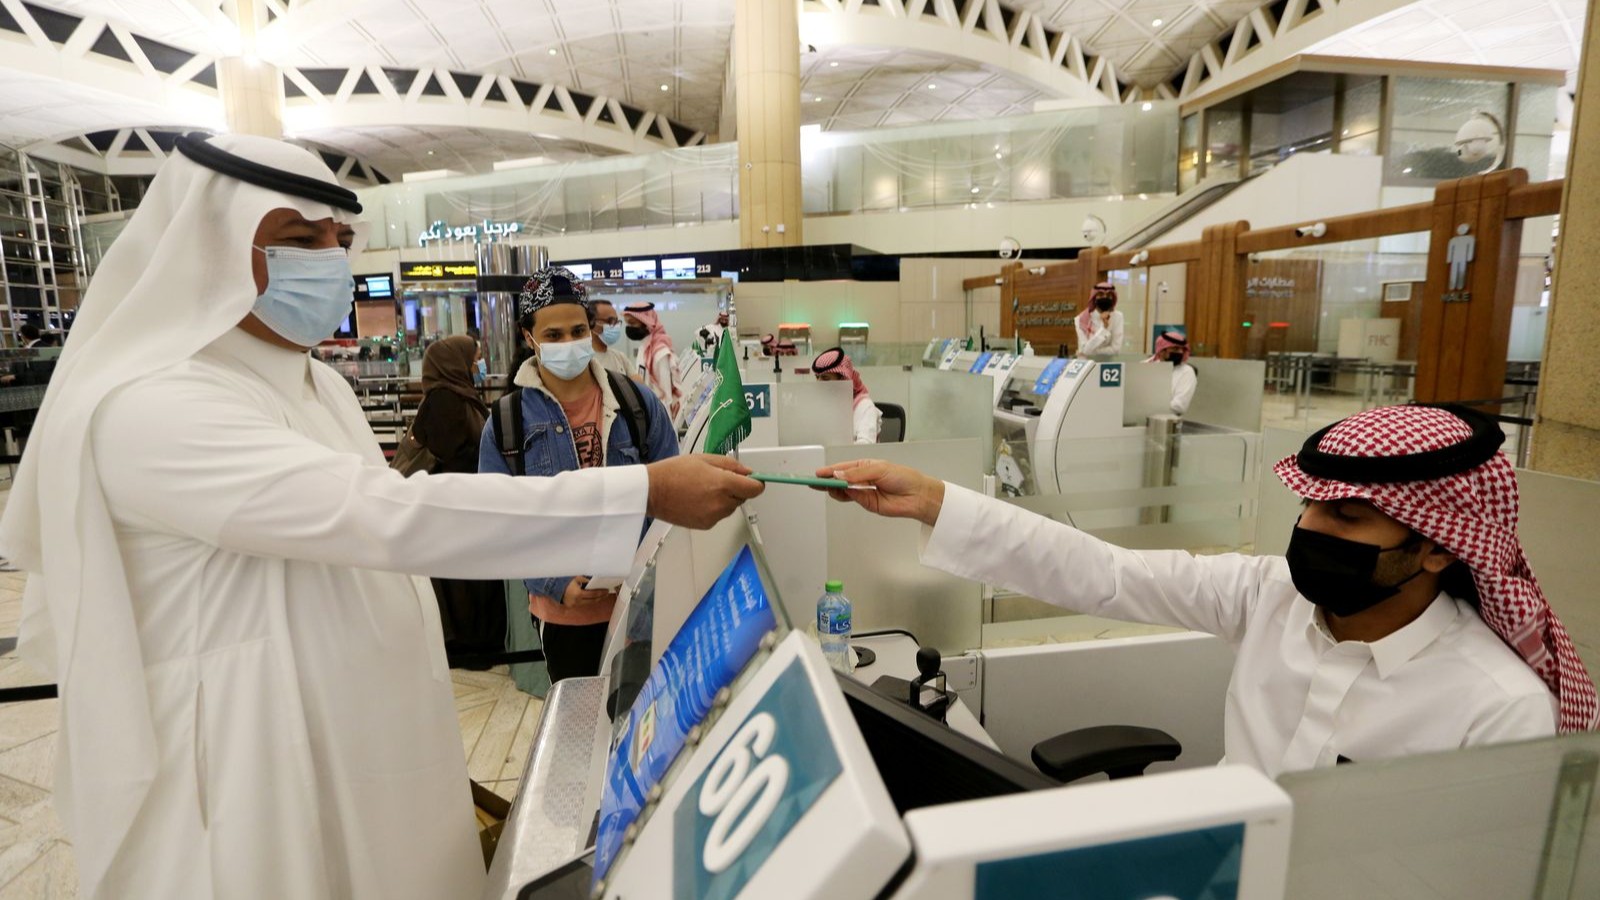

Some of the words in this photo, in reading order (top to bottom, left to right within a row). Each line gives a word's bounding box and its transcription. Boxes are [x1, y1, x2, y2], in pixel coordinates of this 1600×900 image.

[593, 270, 605, 279] 211
[610, 268, 622, 278] 212
[697, 264, 711, 273] 213
[1102, 368, 1120, 382] 62
[744, 391, 765, 410] 61
[699, 711, 789, 873] 60
